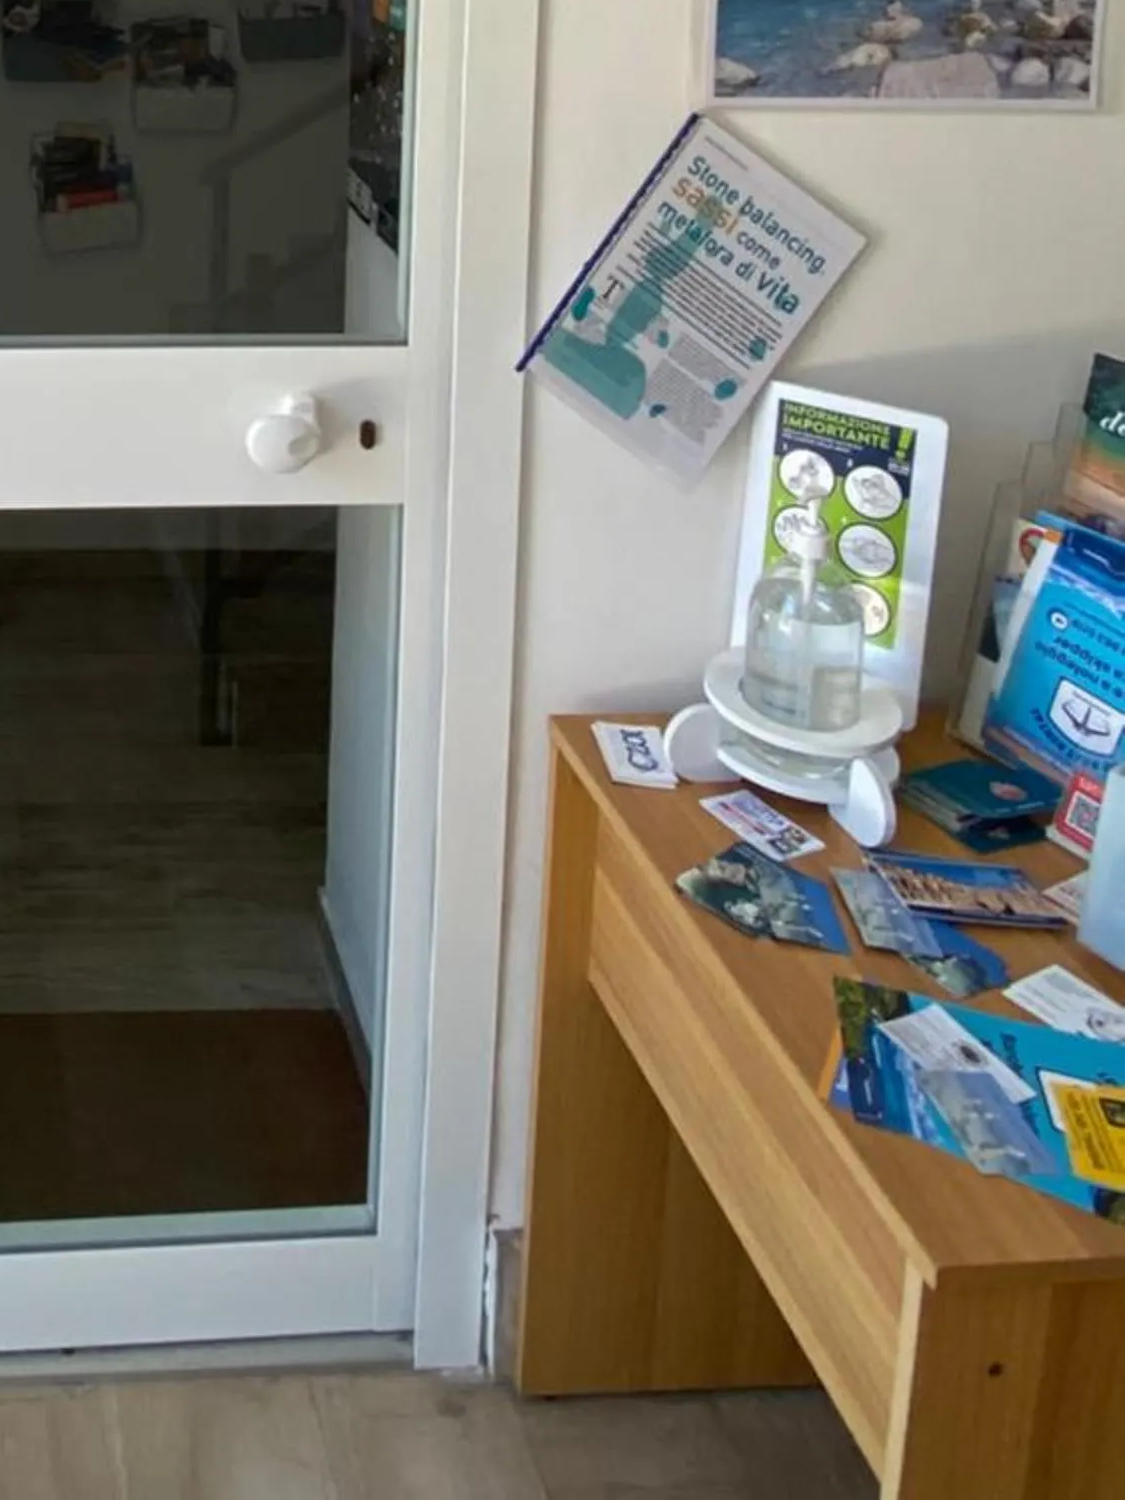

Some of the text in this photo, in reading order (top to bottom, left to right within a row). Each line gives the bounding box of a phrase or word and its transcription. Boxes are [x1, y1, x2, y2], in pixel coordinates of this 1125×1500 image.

[657, 200, 733, 267] metafora
[734, 258, 756, 283] di
[688, 155, 827, 275] Stone balancing
[736, 231, 780, 270] come
